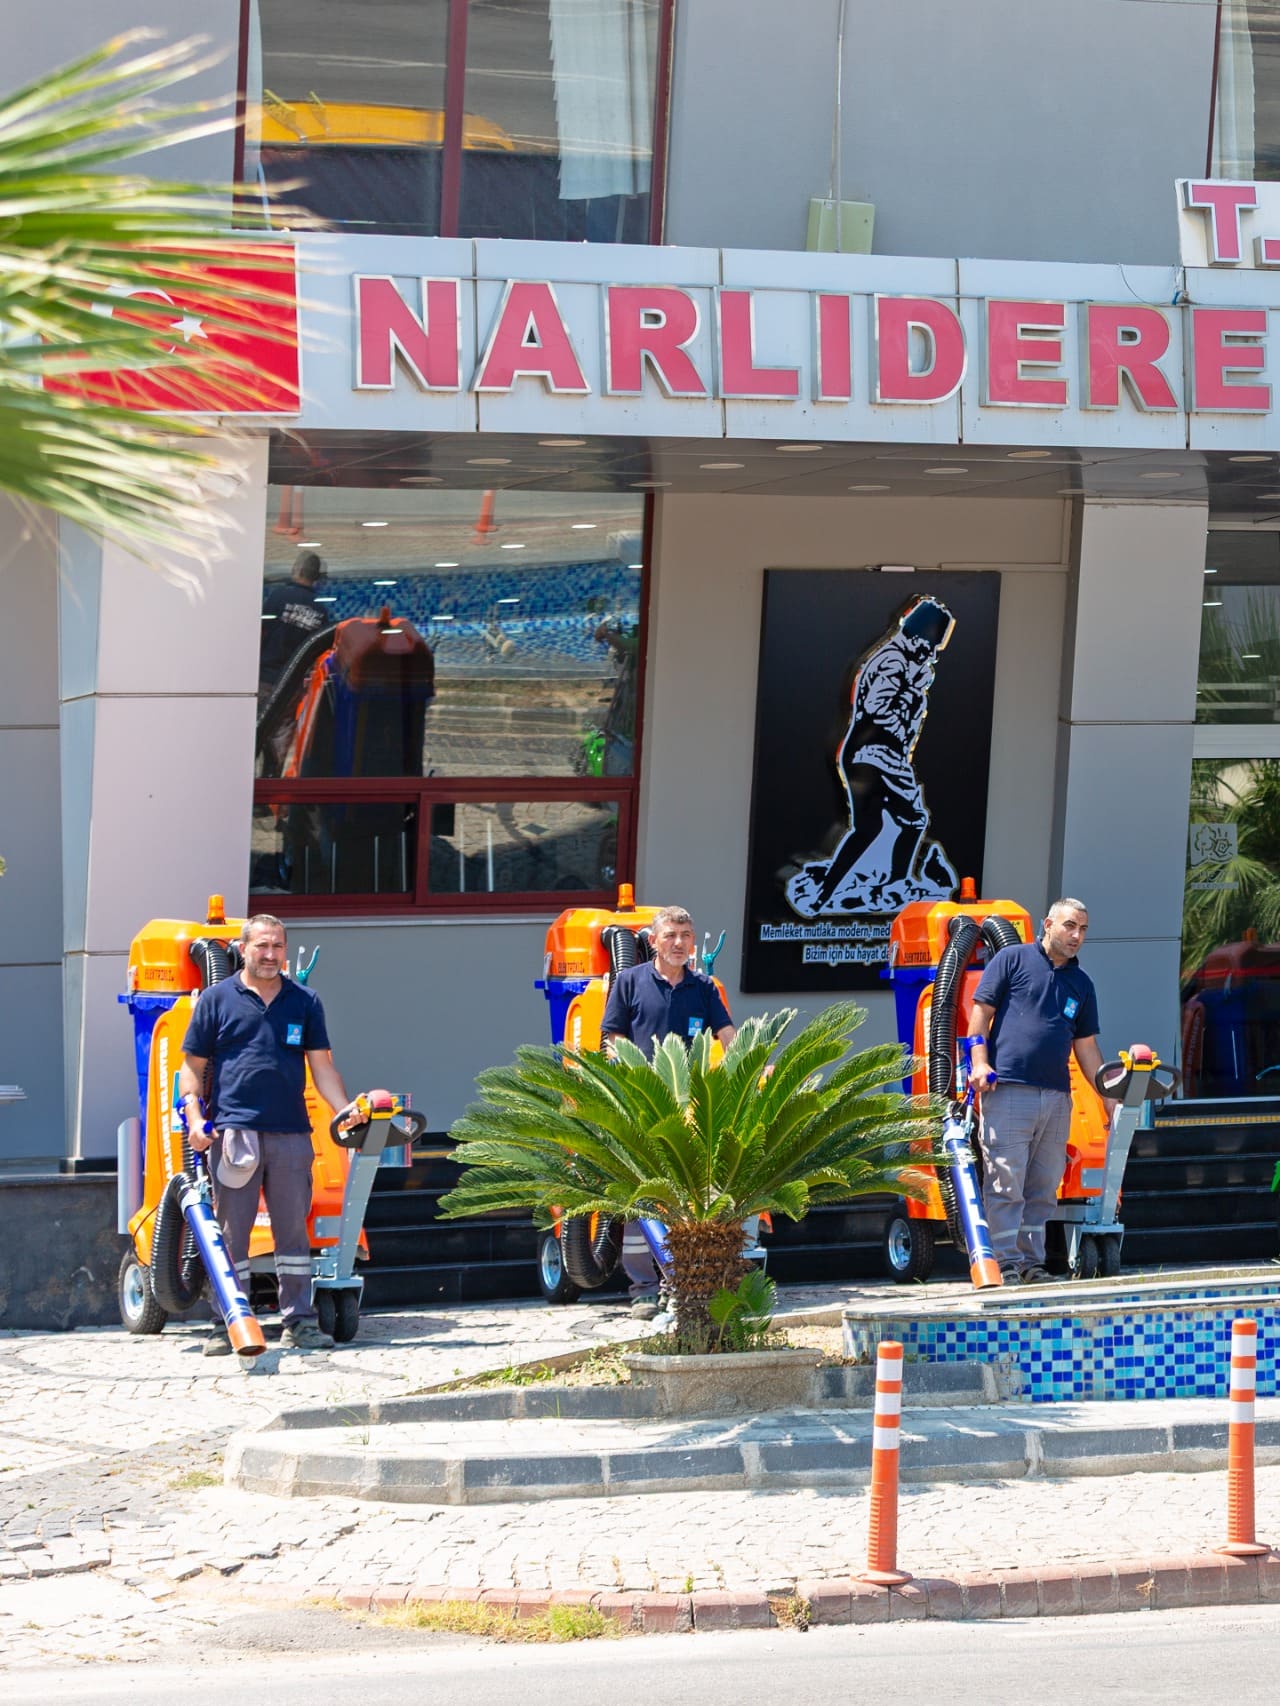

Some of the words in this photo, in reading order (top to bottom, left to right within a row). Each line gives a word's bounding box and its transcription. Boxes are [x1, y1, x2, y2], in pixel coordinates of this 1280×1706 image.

[353, 273, 1273, 415] NARLIDERE
[761, 923, 802, 939] Memleket
[804, 923, 836, 938] mutlaka
[838, 922, 872, 940] modern,
[804, 946, 828, 961] Bizim
[829, 946, 843, 964] için
[845, 945, 855, 960] bu
[857, 945, 879, 964] hayat
